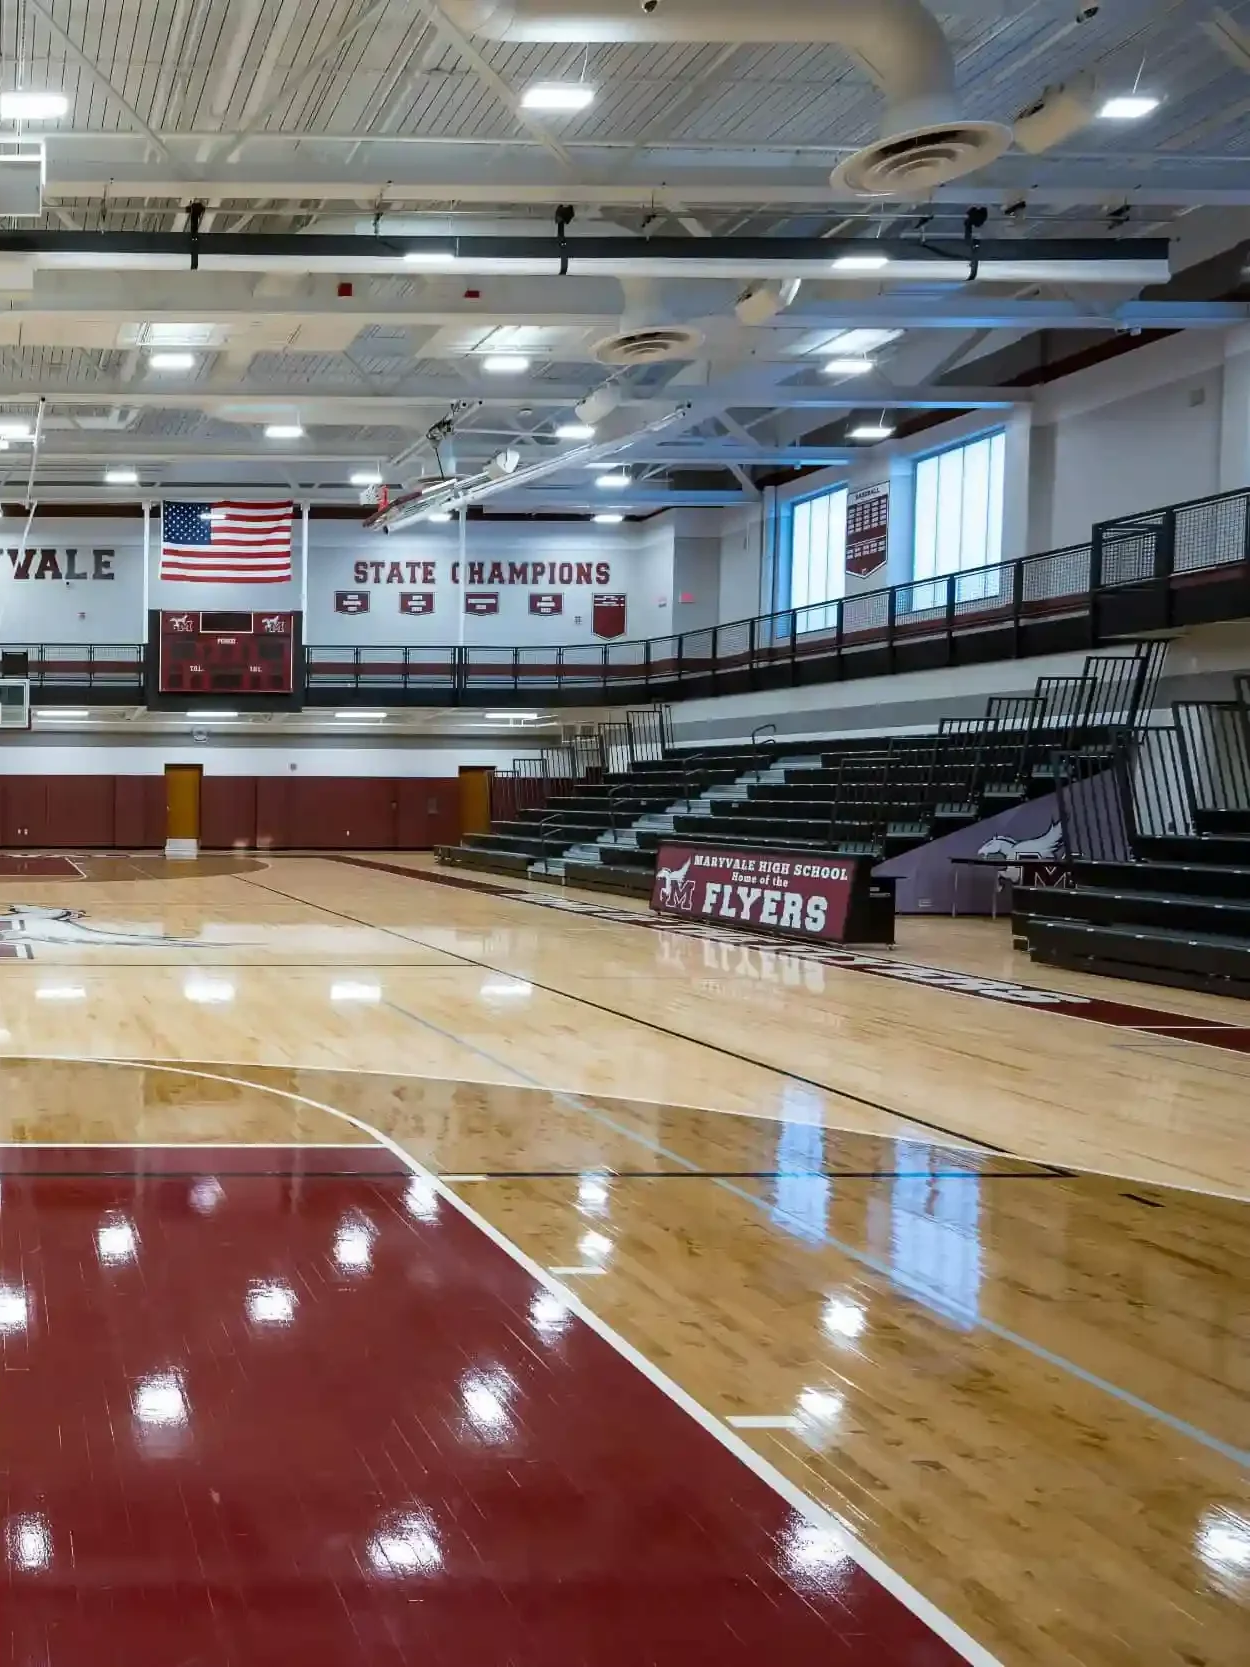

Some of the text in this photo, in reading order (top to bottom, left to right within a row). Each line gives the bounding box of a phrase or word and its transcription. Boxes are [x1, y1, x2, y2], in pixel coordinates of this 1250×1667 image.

[354, 560, 611, 585] STATE CHAMPIONS
[693, 854, 848, 881] MARYVALE HIGH SCHOOL
[731, 871, 789, 888] Home of the
[665, 878, 696, 911] M
[701, 882, 829, 933] FLYERS
